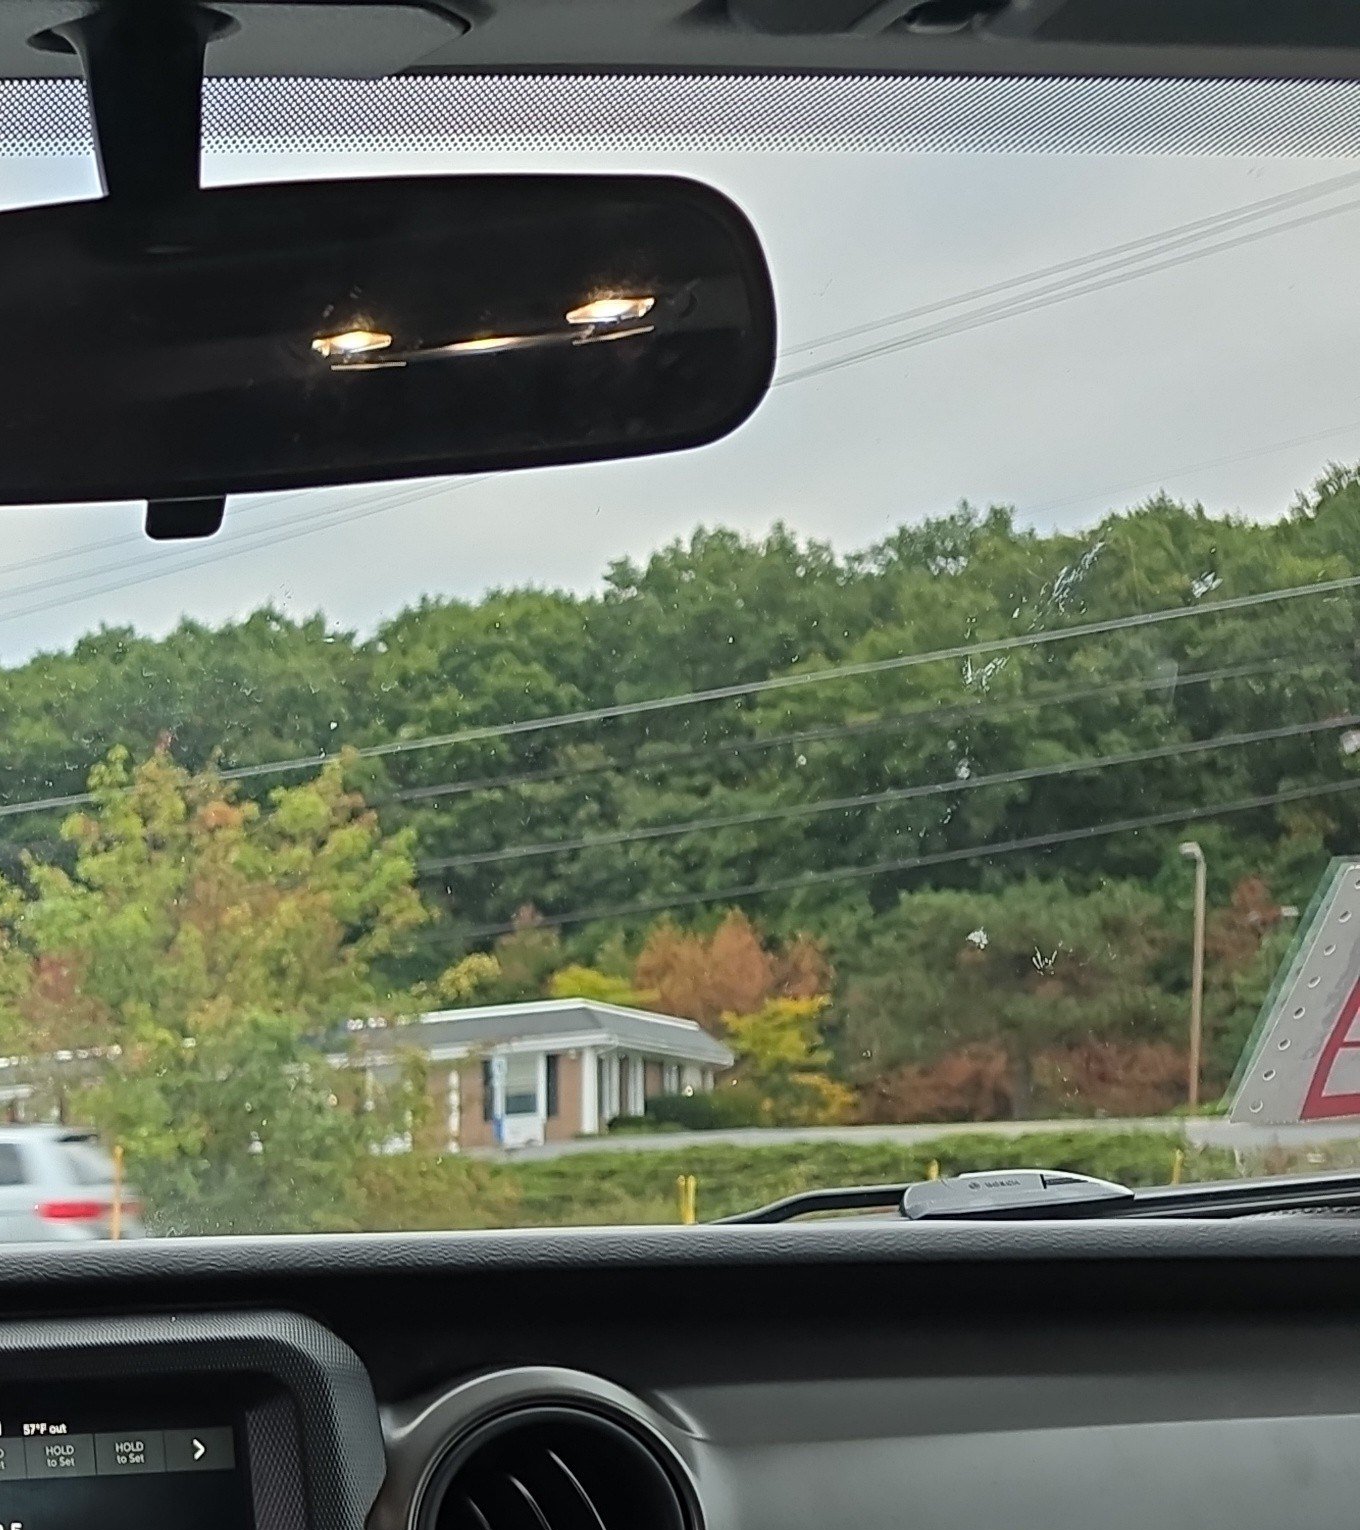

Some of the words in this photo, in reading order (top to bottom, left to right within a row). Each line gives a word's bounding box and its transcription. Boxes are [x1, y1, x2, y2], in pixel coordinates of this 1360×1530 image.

[48, 1423, 67, 1434] out
[45, 1445, 74, 1456] HOLD
[115, 1442, 144, 1453] HOLD
[47, 1458, 56, 1467] to
[58, 1456, 75, 1467] Set
[116, 1454, 126, 1464] to
[128, 1453, 144, 1464] Set
